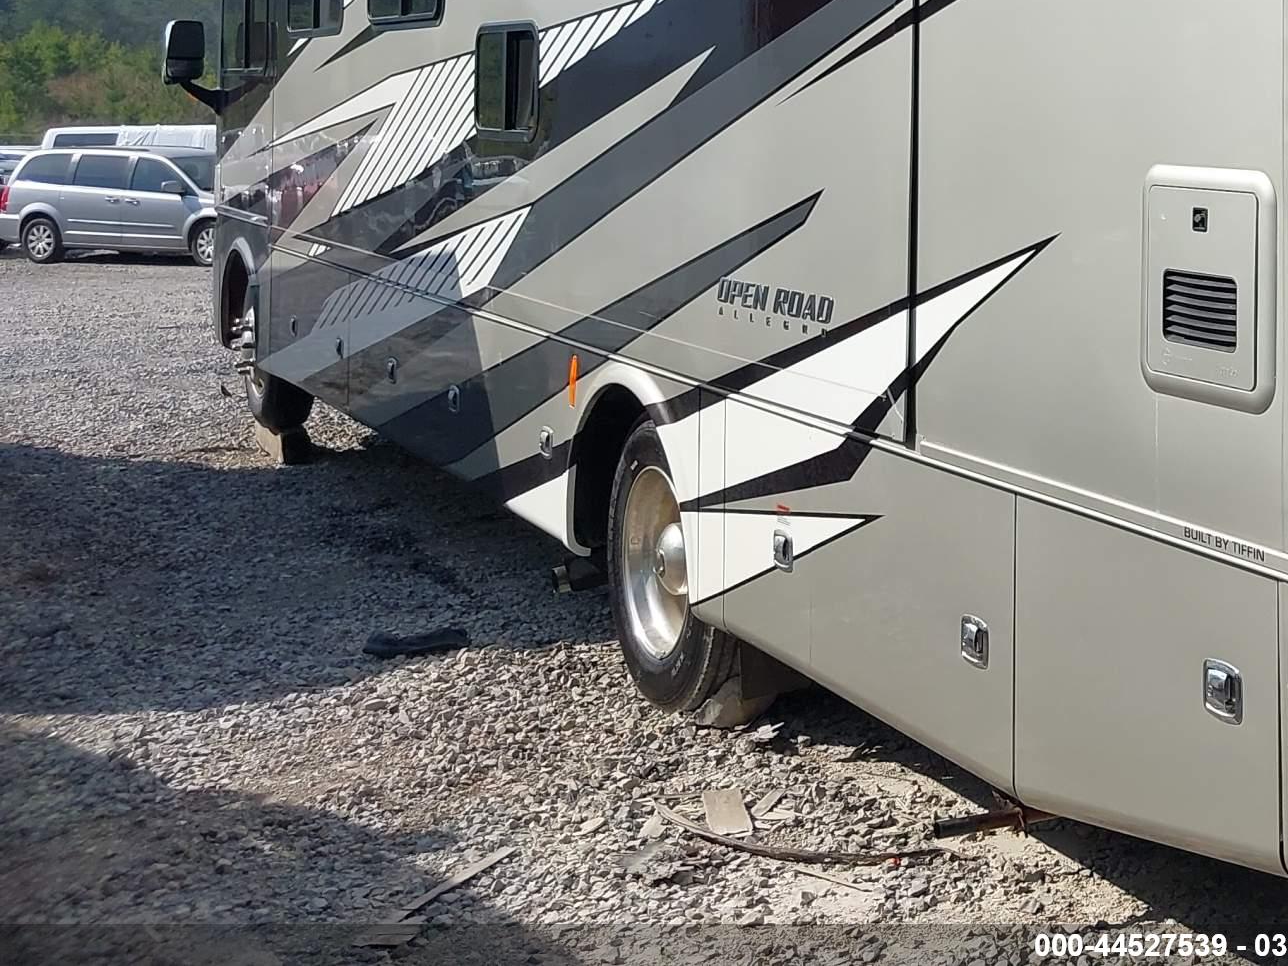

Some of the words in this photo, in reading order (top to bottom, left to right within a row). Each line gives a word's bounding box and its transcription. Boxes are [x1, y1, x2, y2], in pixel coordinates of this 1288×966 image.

[716, 277, 769, 312] OPEN
[772, 287, 835, 324] ROAD
[1183, 526, 1212, 546] BUILT
[1215, 535, 1229, 551] BY
[1231, 540, 1265, 562] TIFFIN
